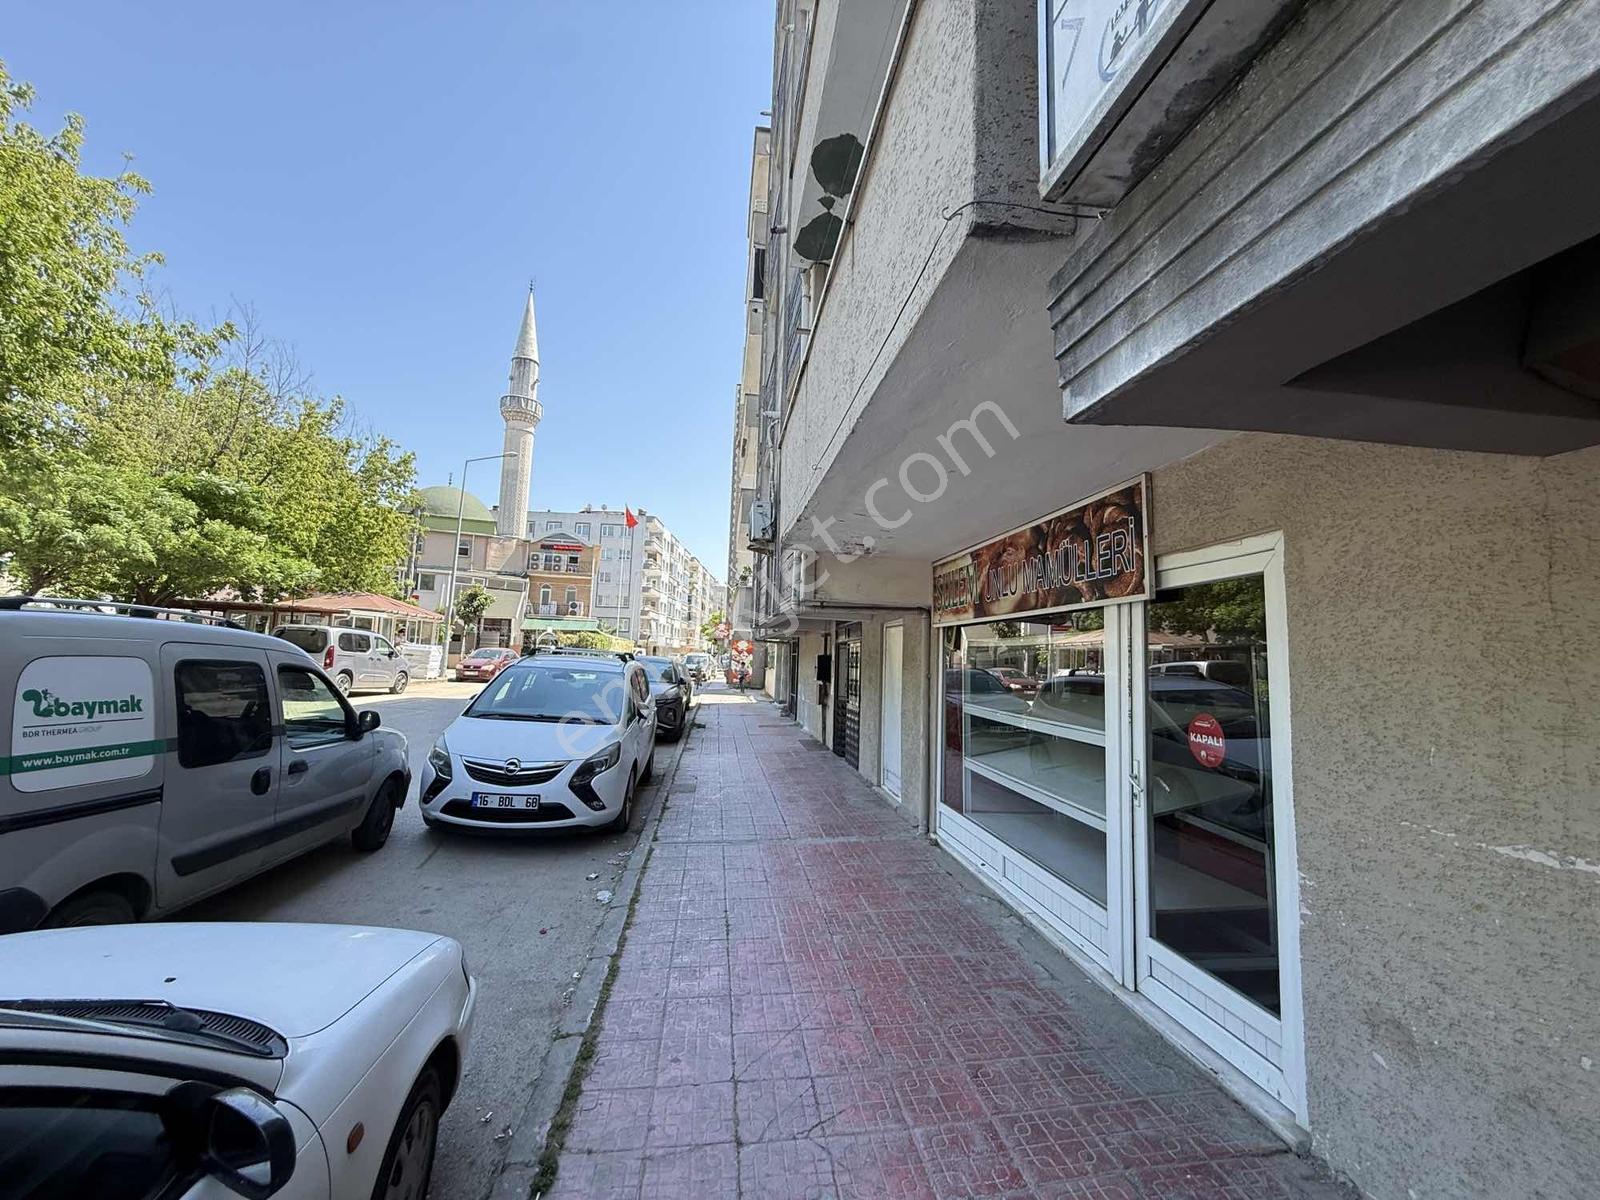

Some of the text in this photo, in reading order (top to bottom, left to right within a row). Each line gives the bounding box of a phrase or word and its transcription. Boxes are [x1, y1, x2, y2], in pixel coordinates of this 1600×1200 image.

[1022, 516, 1136, 595] MAMÜLLERİ
[54, 695, 143, 719] baymak
[22, 730, 40, 738] BDR
[41, 727, 78, 737] THERMEA
[1190, 732, 1223, 747] KAPALI
[22, 747, 130, 768] www.baymak.com.tr
[479, 794, 538, 808] 16 BDL 68
